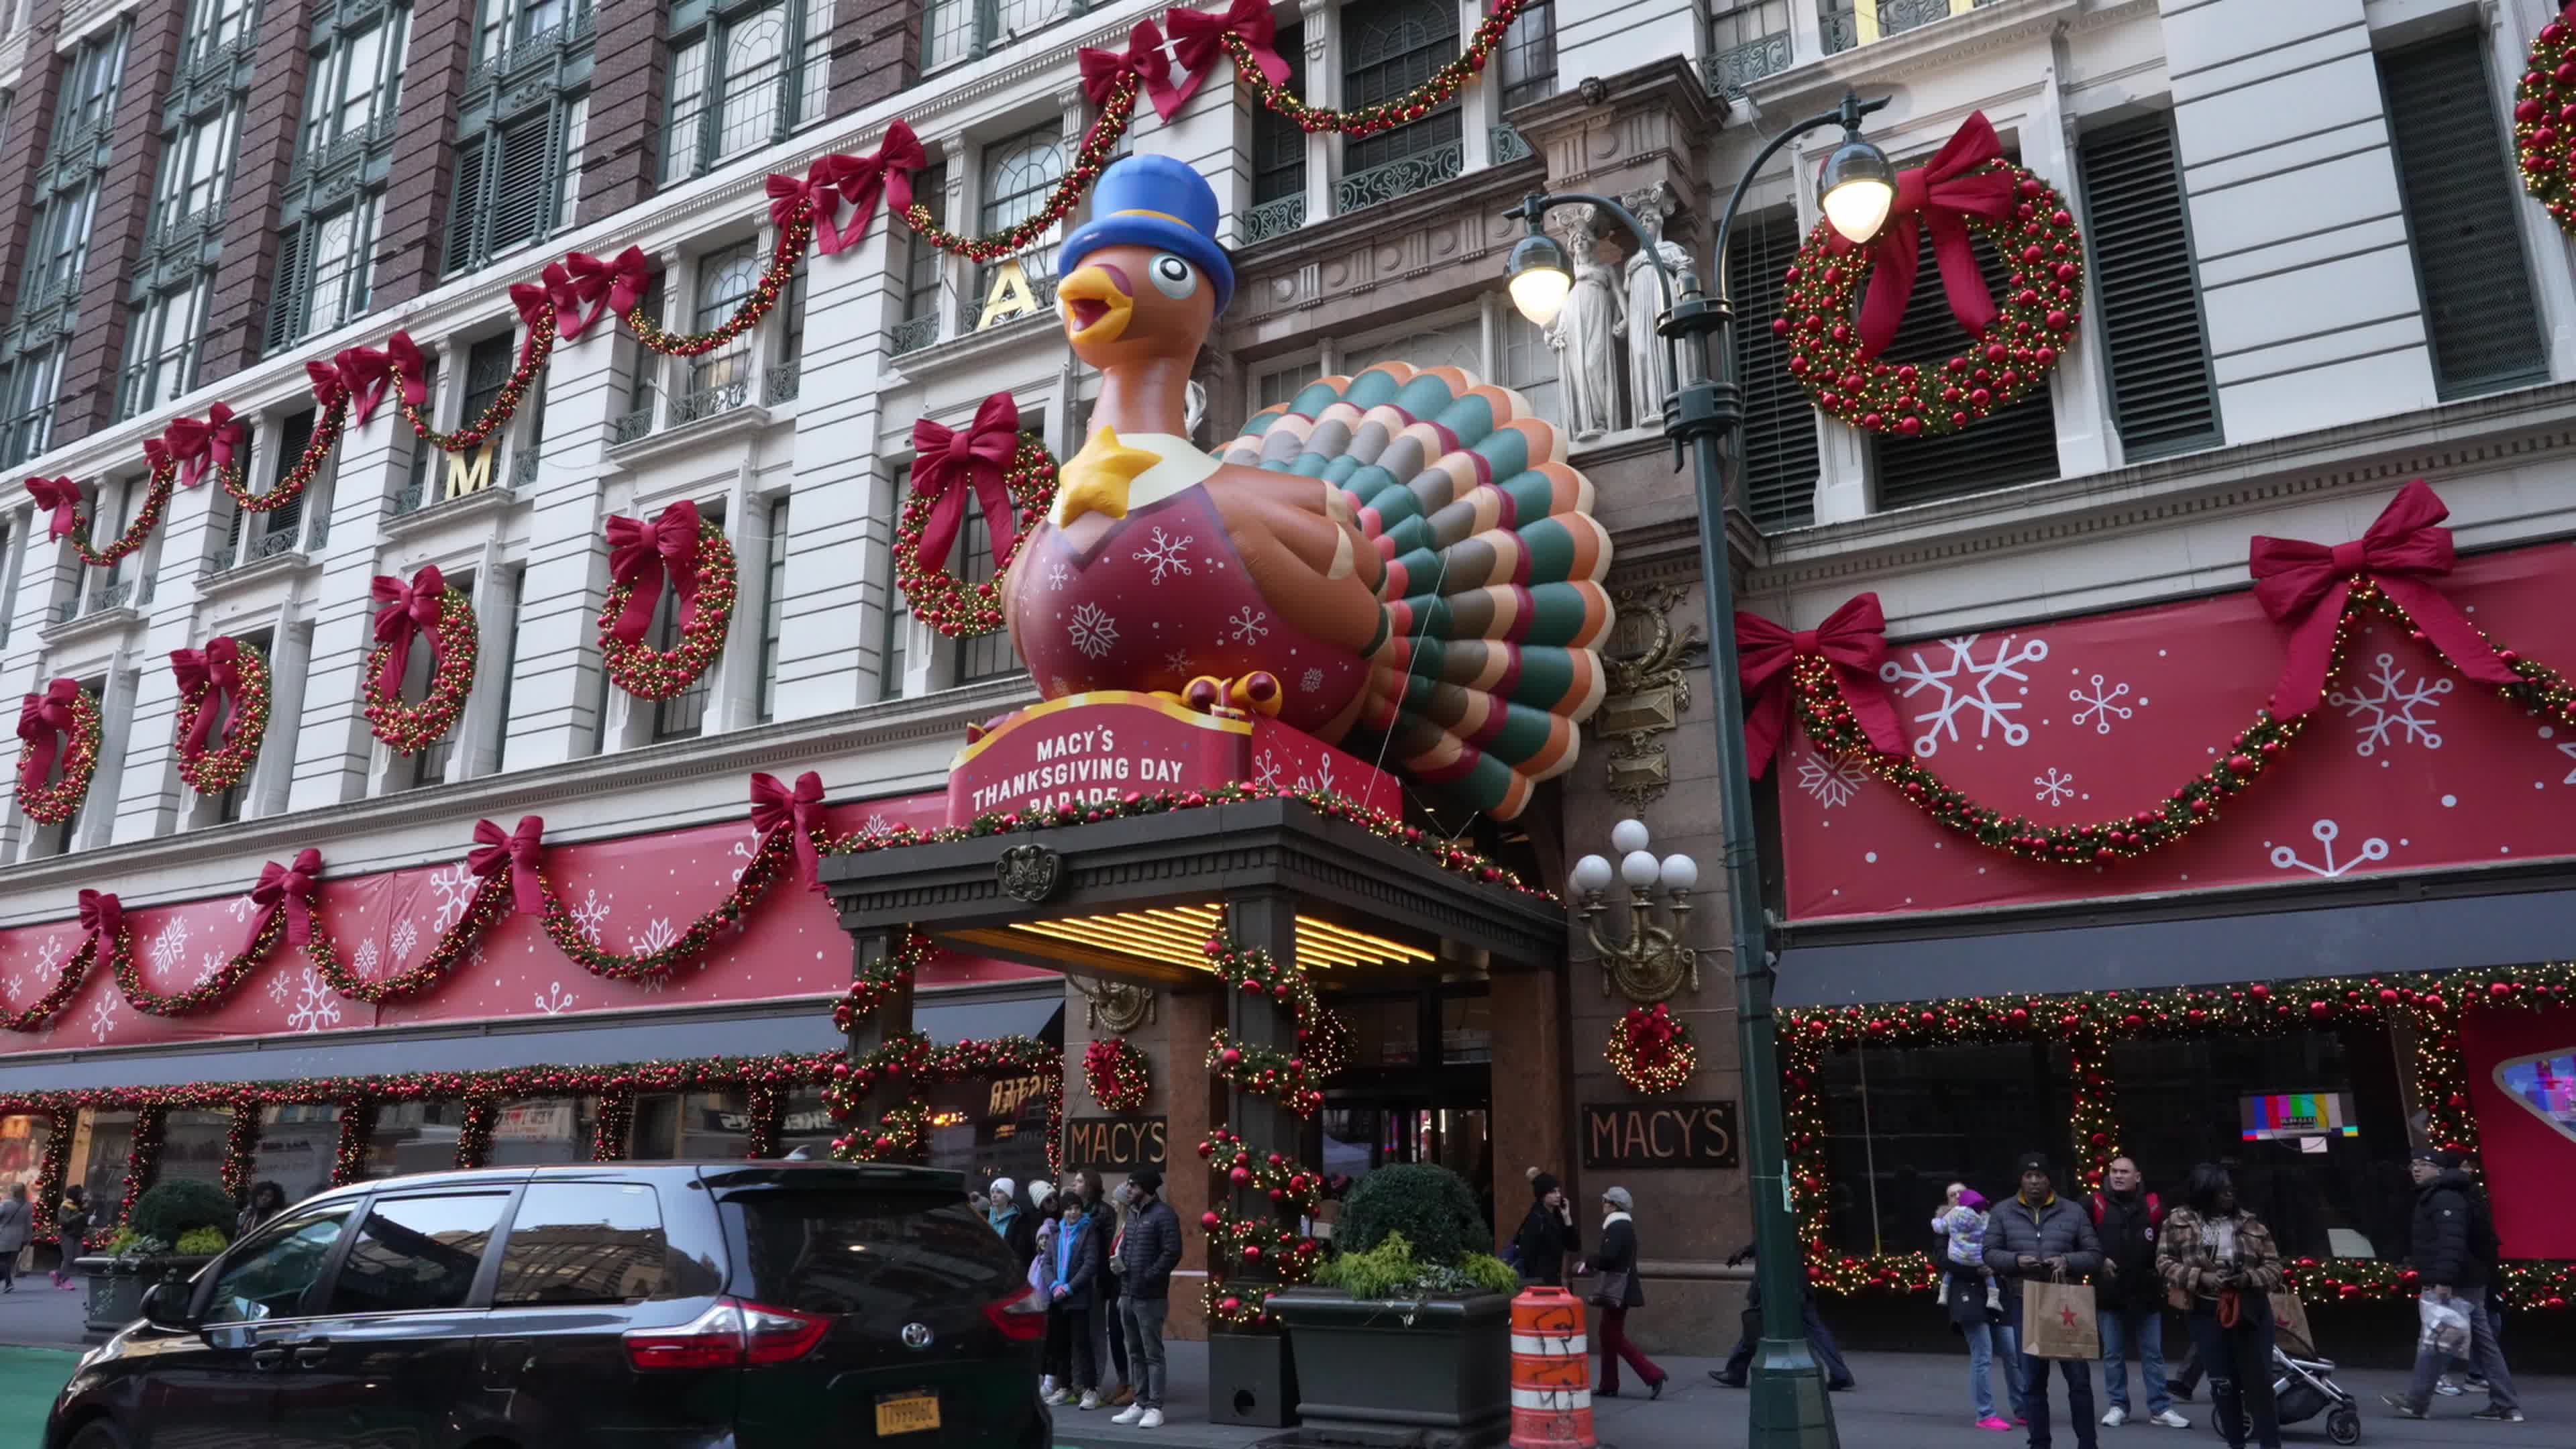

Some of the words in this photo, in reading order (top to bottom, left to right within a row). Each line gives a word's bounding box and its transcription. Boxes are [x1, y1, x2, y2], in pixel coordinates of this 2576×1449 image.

[976, 258, 1037, 332] A
[445, 439, 499, 501] M
[1036, 724, 1114, 763] MACY'S
[973, 758, 1129, 811] THANKSGIVING
[1140, 758, 1183, 784] DAY
[1071, 1121, 1166, 1163] MACY'S
[1591, 1107, 1729, 1159] MACY'S
